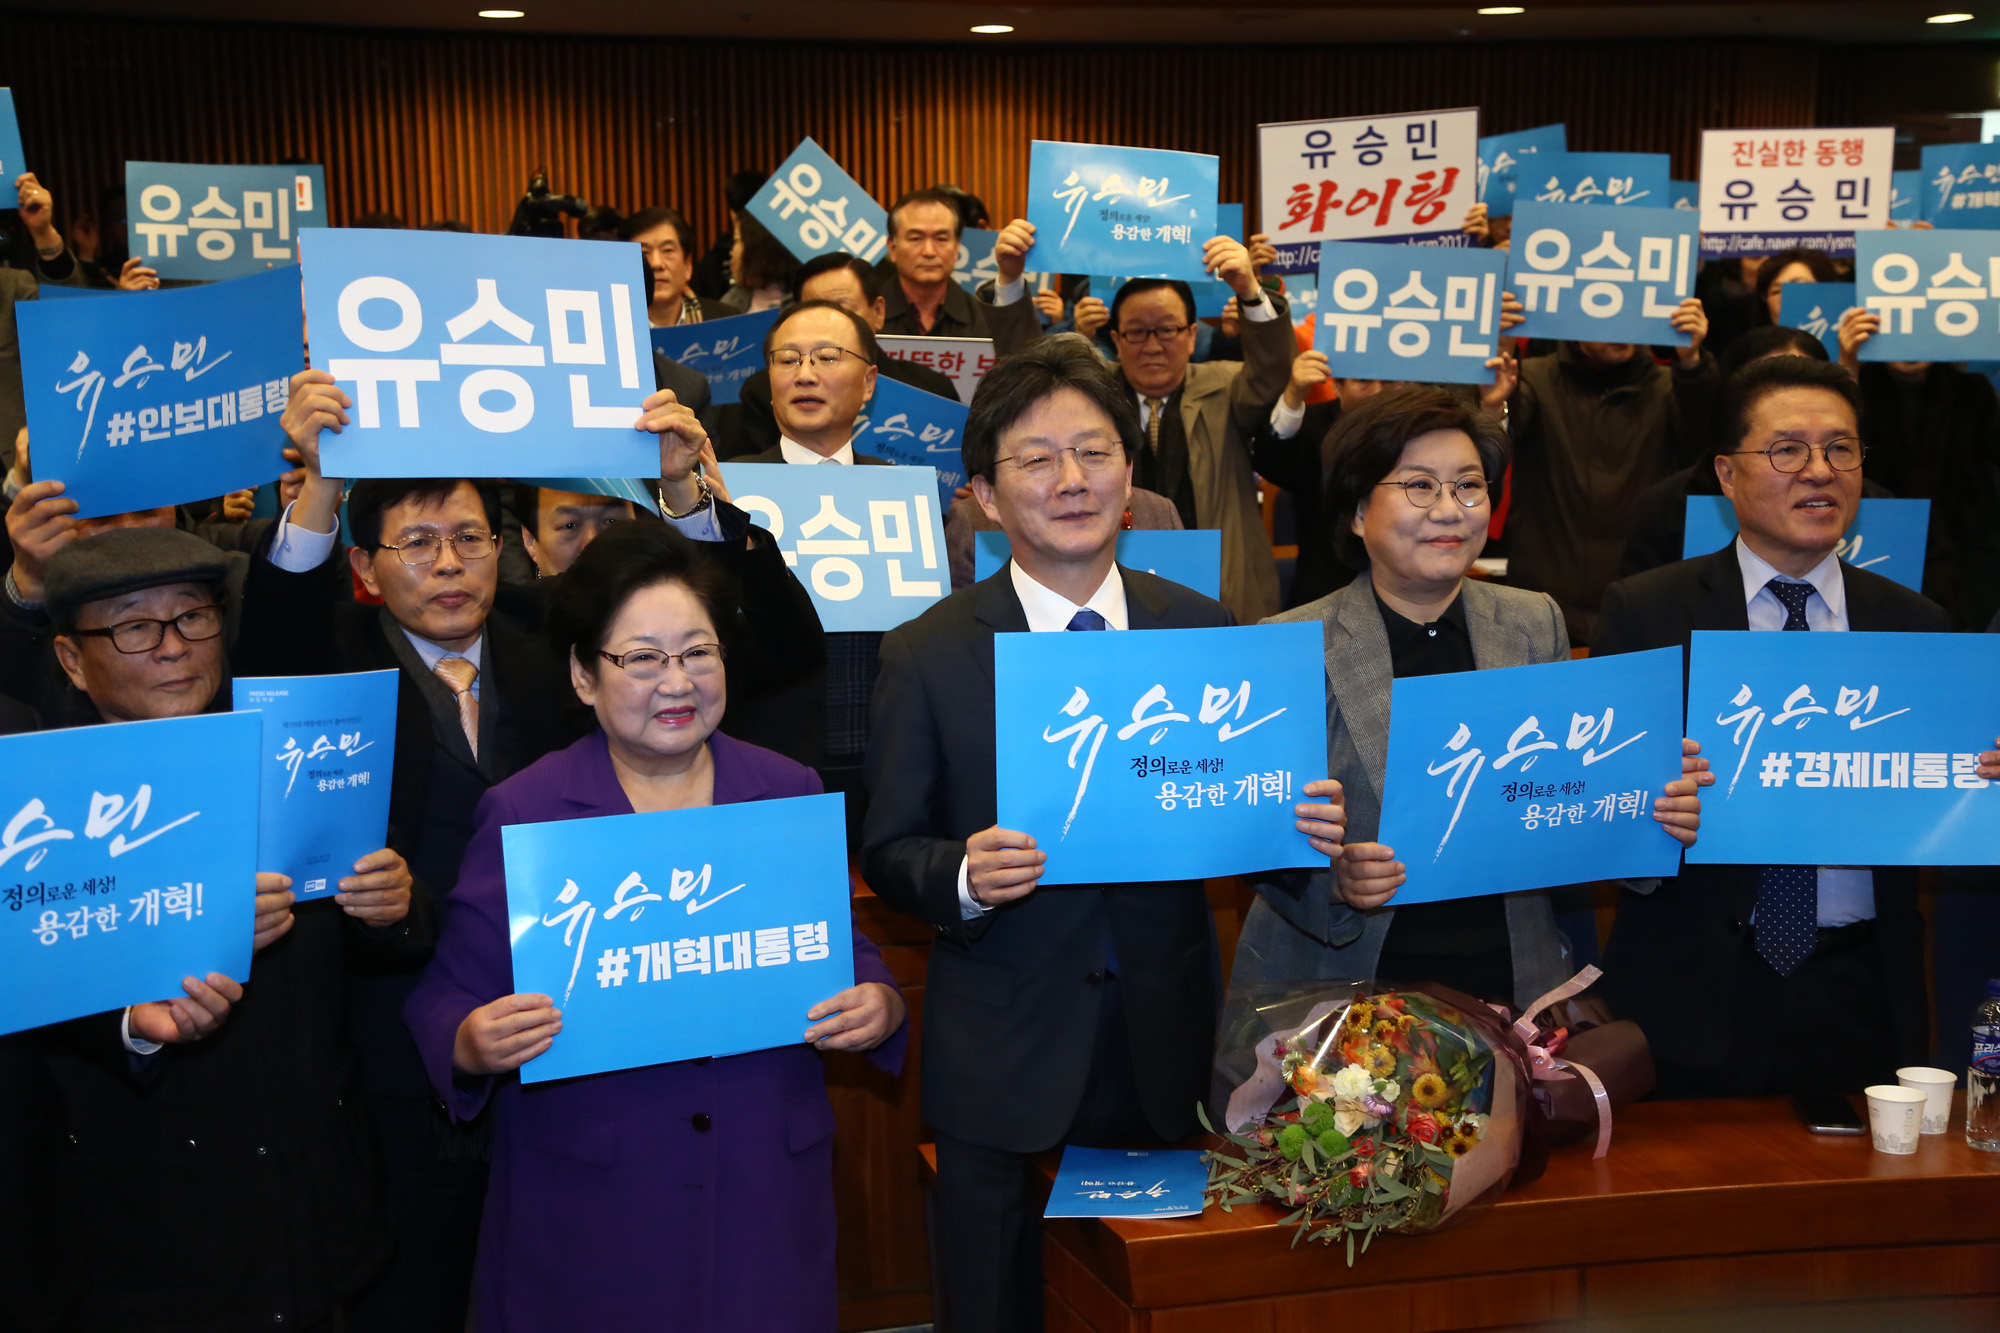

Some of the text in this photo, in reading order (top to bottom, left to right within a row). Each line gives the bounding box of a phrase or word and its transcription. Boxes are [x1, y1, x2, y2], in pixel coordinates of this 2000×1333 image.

[1732, 138, 1865, 167] 진실한 동행
[1053, 170, 1191, 250] 유승민
[1111, 223, 1192, 244] 용감한 개혁!
[1278, 167, 1460, 233] 화이팅
[1514, 228, 1691, 318] 유승민
[1324, 268, 1496, 358] 유승민
[329, 276, 644, 433] 유승민
[657, 336, 757, 365] 승민
[55, 335, 232, 463] 유승민
[106, 376, 291, 447] #안보대통령
[276, 731, 375, 799] 유승민
[1042, 680, 1287, 842] 유승민
[1130, 755, 1224, 778] 정의로운 세상!
[1716, 683, 1911, 801] 유승민
[1759, 752, 1990, 789] #경제대통령
[317, 779, 345, 792] 용감한
[347, 771, 370, 786] 개혁!
[1155, 770, 1292, 811] 용감한 개혁!
[1426, 707, 1648, 865] 유승민
[1500, 781, 1586, 803] 정의로운 세상!
[1520, 790, 1649, 830] 용감한 개혁!
[2, 876, 116, 911] 정의로운 세상!
[32, 882, 203, 945] 용감한 개혁!
[542, 863, 746, 1008] 유승민
[596, 920, 830, 989] #개혁대통령
